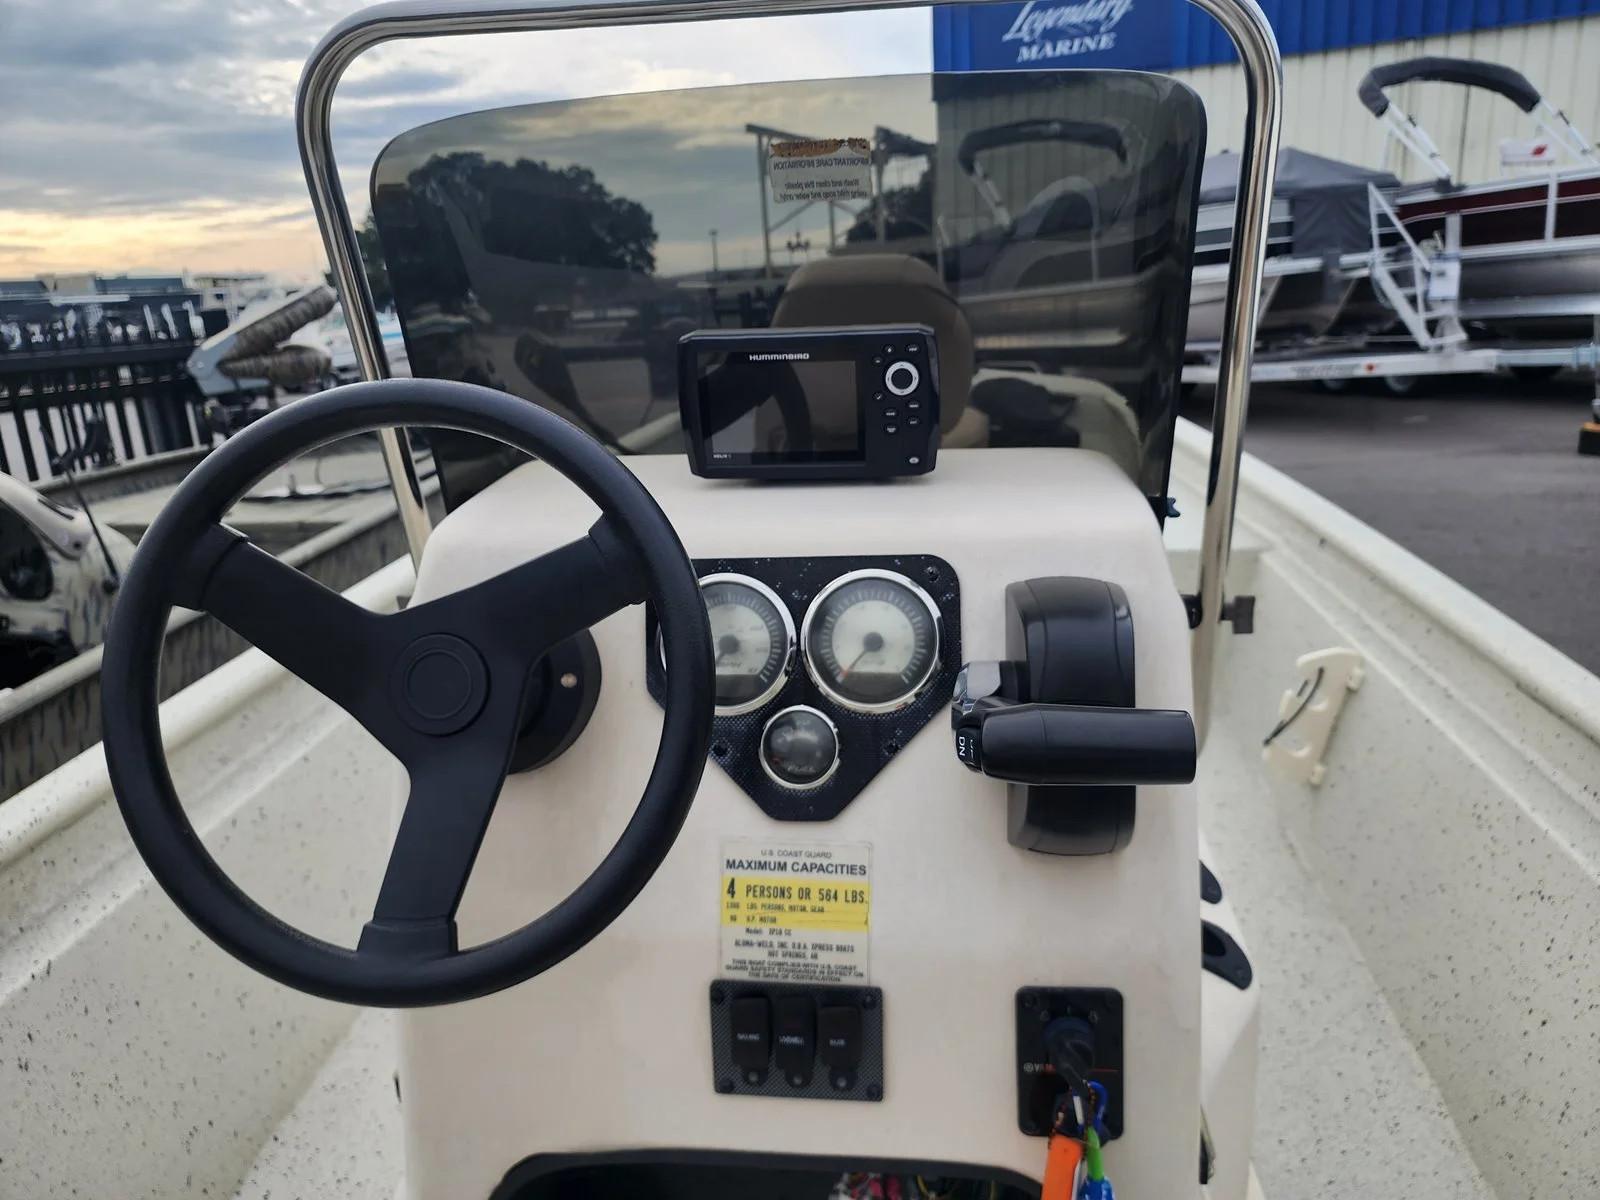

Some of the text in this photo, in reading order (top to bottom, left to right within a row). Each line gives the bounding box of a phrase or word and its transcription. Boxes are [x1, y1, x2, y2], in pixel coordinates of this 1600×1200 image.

[1002, 0, 1133, 42] Legendary
[1016, 32, 1117, 63] MARINE
[749, 352, 810, 361] HUMMINBIRD
[777, 849, 803, 858] COAST
[804, 850, 832, 859] GUARD
[725, 858, 867, 876] MAXIMUM CAPACITIES
[727, 877, 736, 899] 4
[745, 884, 792, 900] PERSONS
[798, 886, 811, 901] OR
